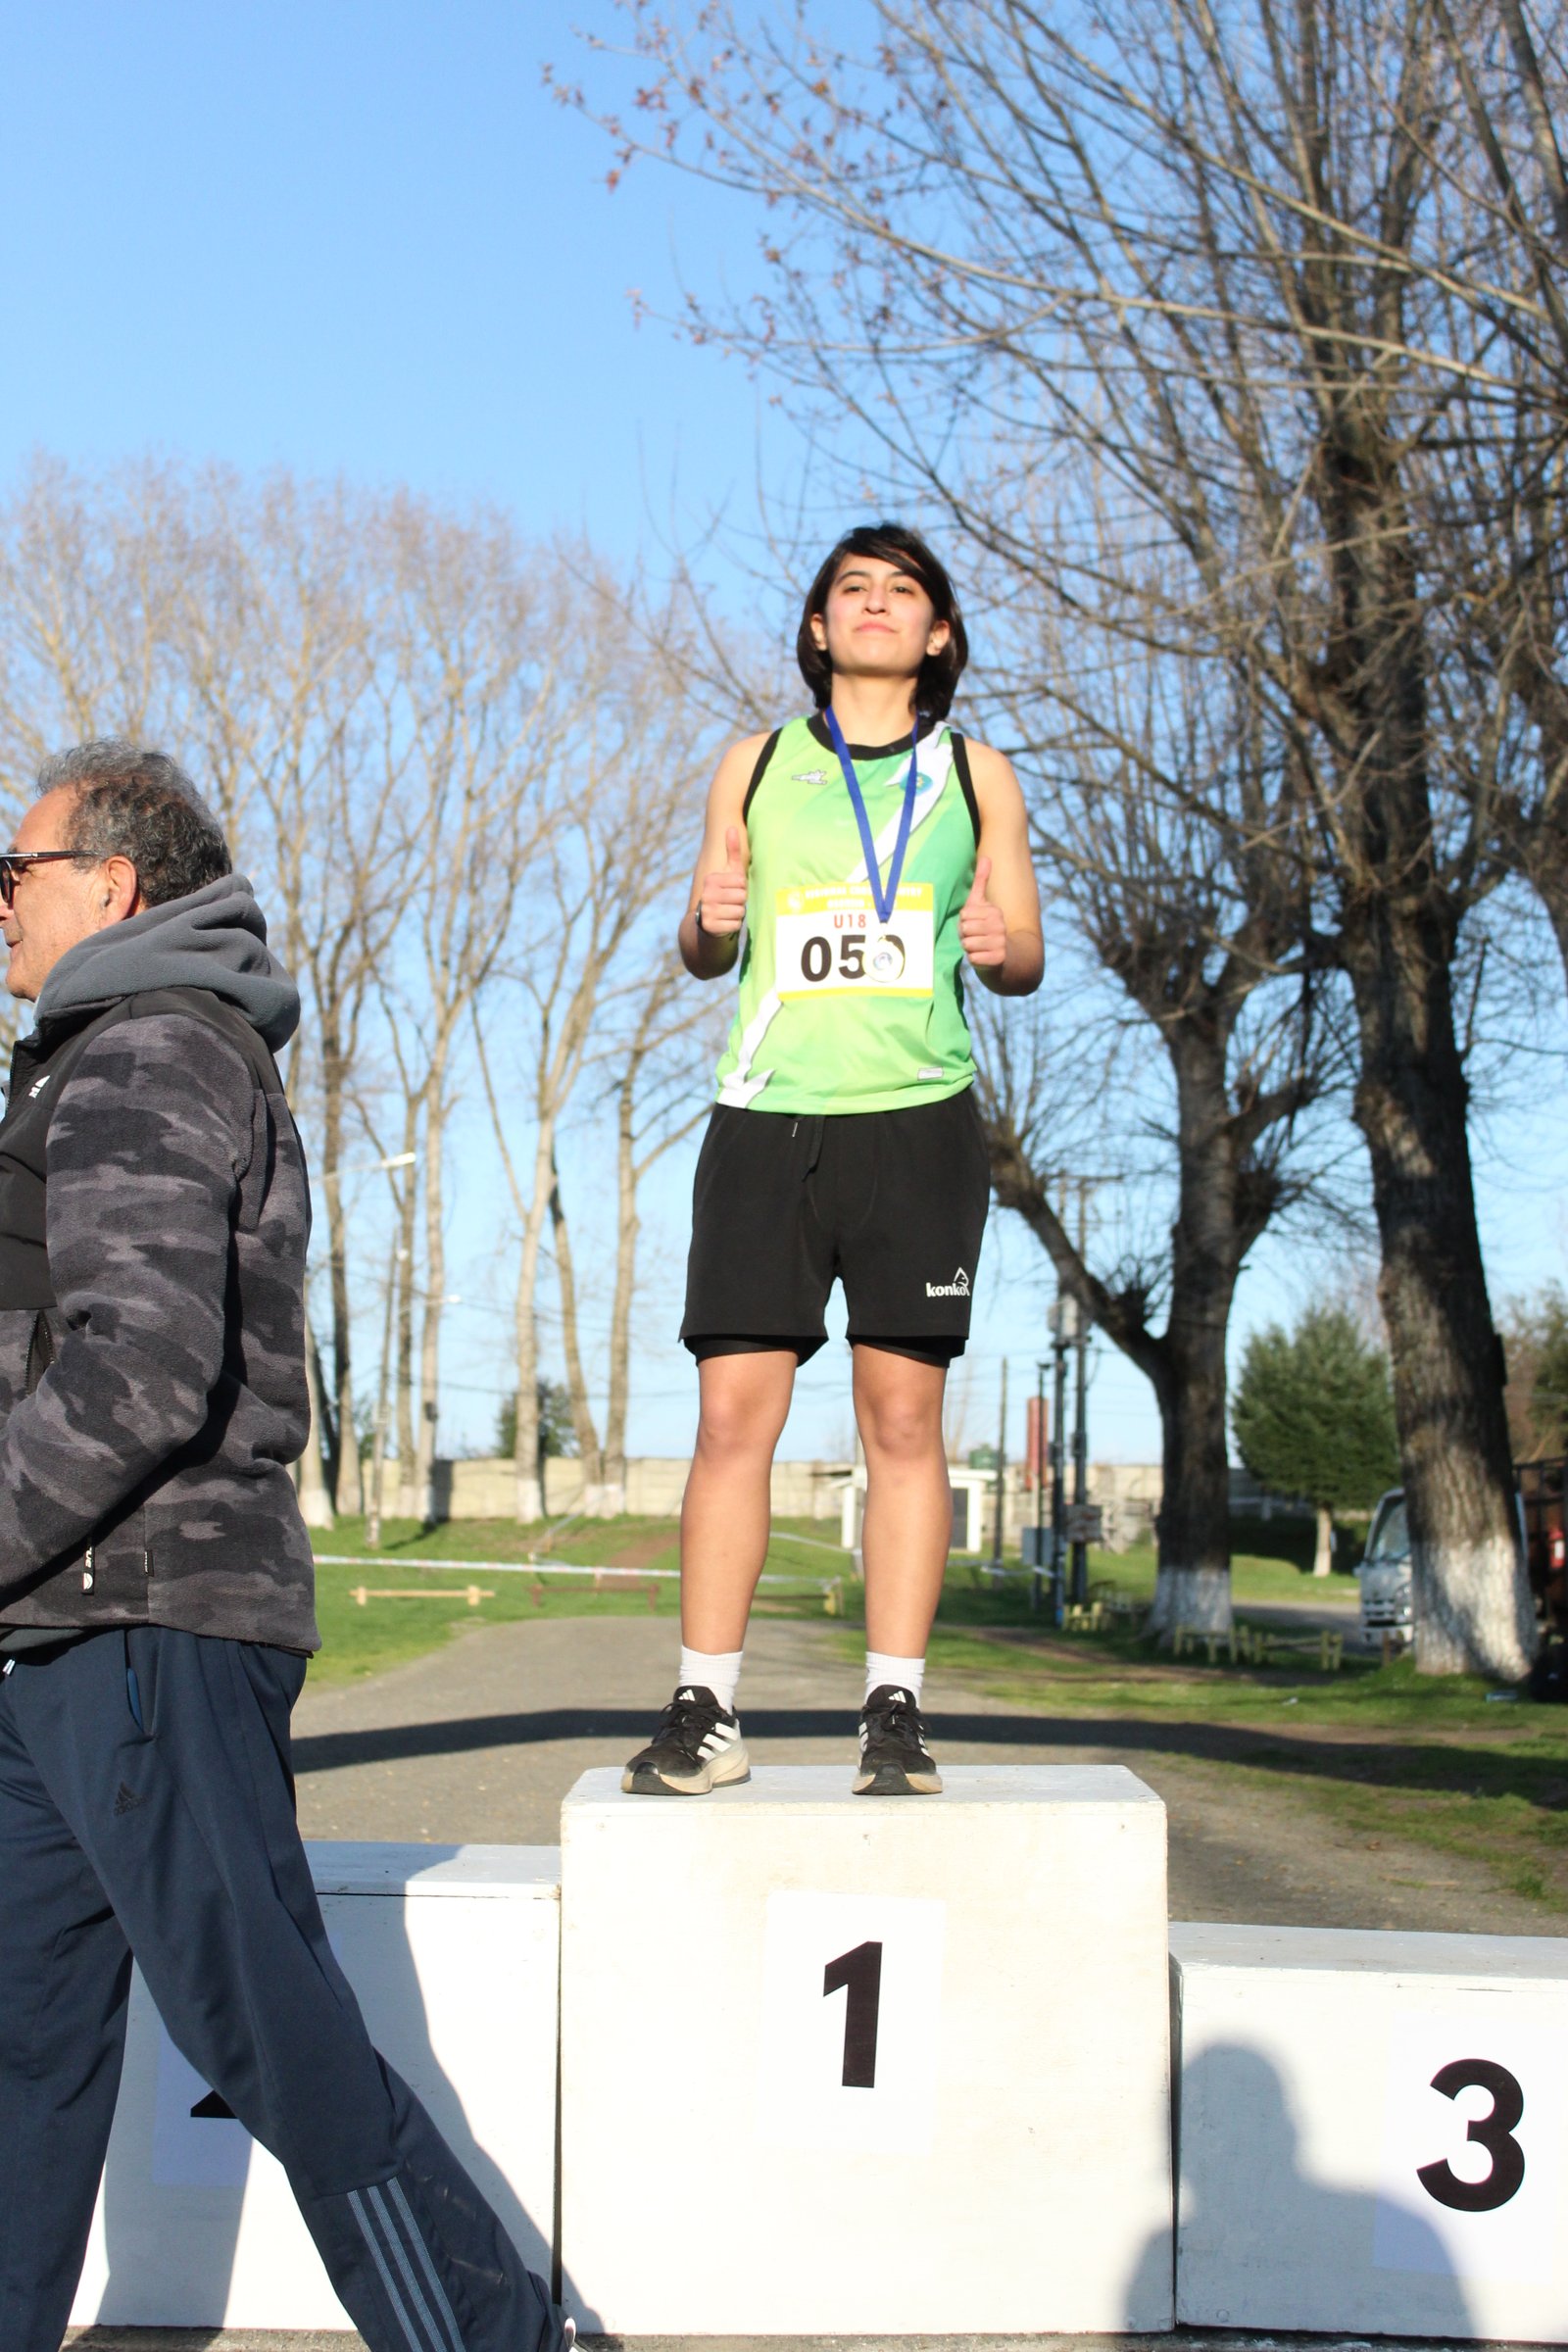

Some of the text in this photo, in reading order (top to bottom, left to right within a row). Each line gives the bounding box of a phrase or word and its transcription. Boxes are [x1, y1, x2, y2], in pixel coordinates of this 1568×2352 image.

[834, 914, 866, 928] U18
[823, 1941, 883, 2088] 1
[1416, 2058, 1525, 2212] 3
